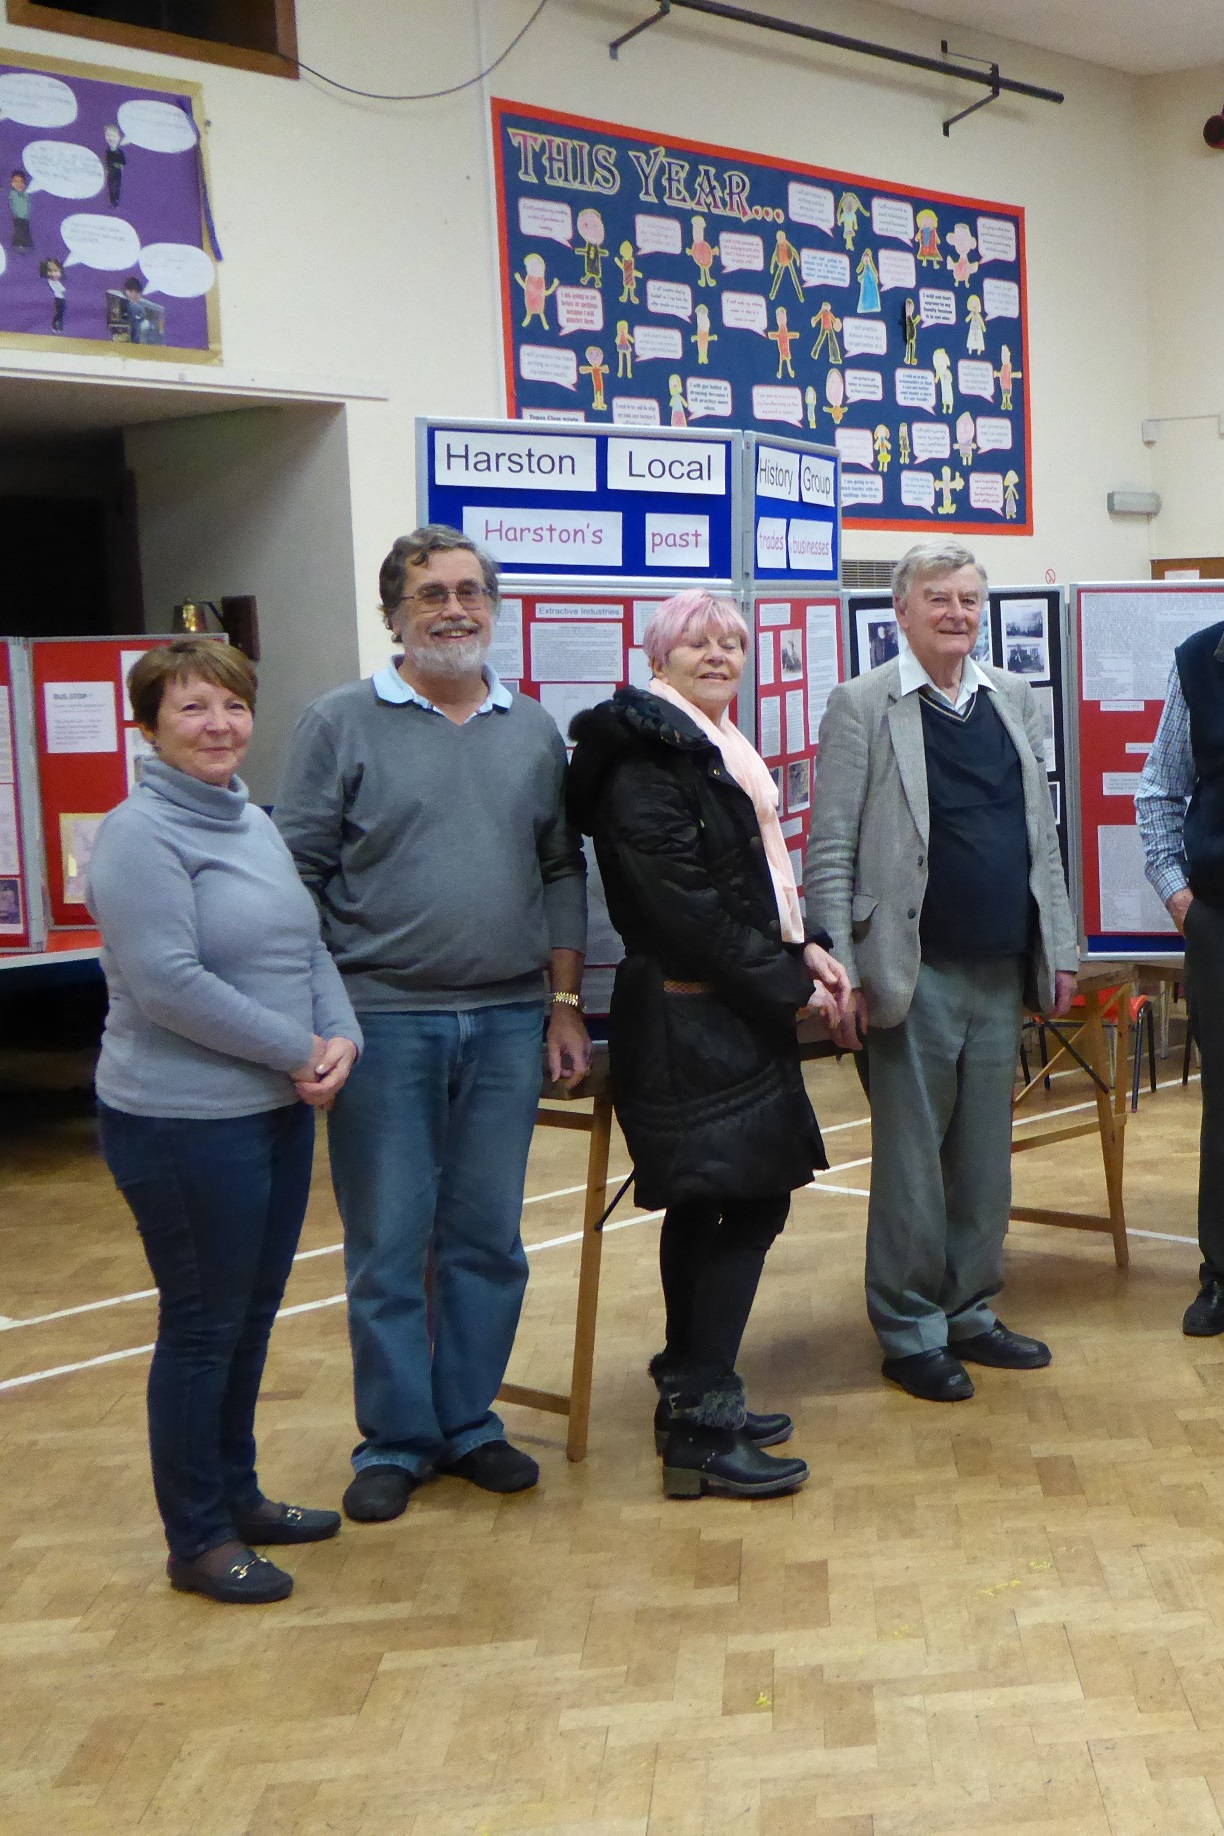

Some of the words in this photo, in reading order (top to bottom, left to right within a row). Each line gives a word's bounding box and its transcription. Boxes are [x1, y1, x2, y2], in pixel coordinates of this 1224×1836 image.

[507, 127, 620, 195] THIS
[446, 443, 576, 475] Harston
[629, 450, 712, 481] Local
[760, 456, 794, 495] History
[803, 466, 831, 500] Group
[484, 519, 603, 546] Harston's
[651, 529, 702, 554] past
[759, 531, 784, 551] trades
[793, 536, 830, 556] businesses
[539, 607, 579, 616] Extractive
[581, 607, 620, 616] Industries
